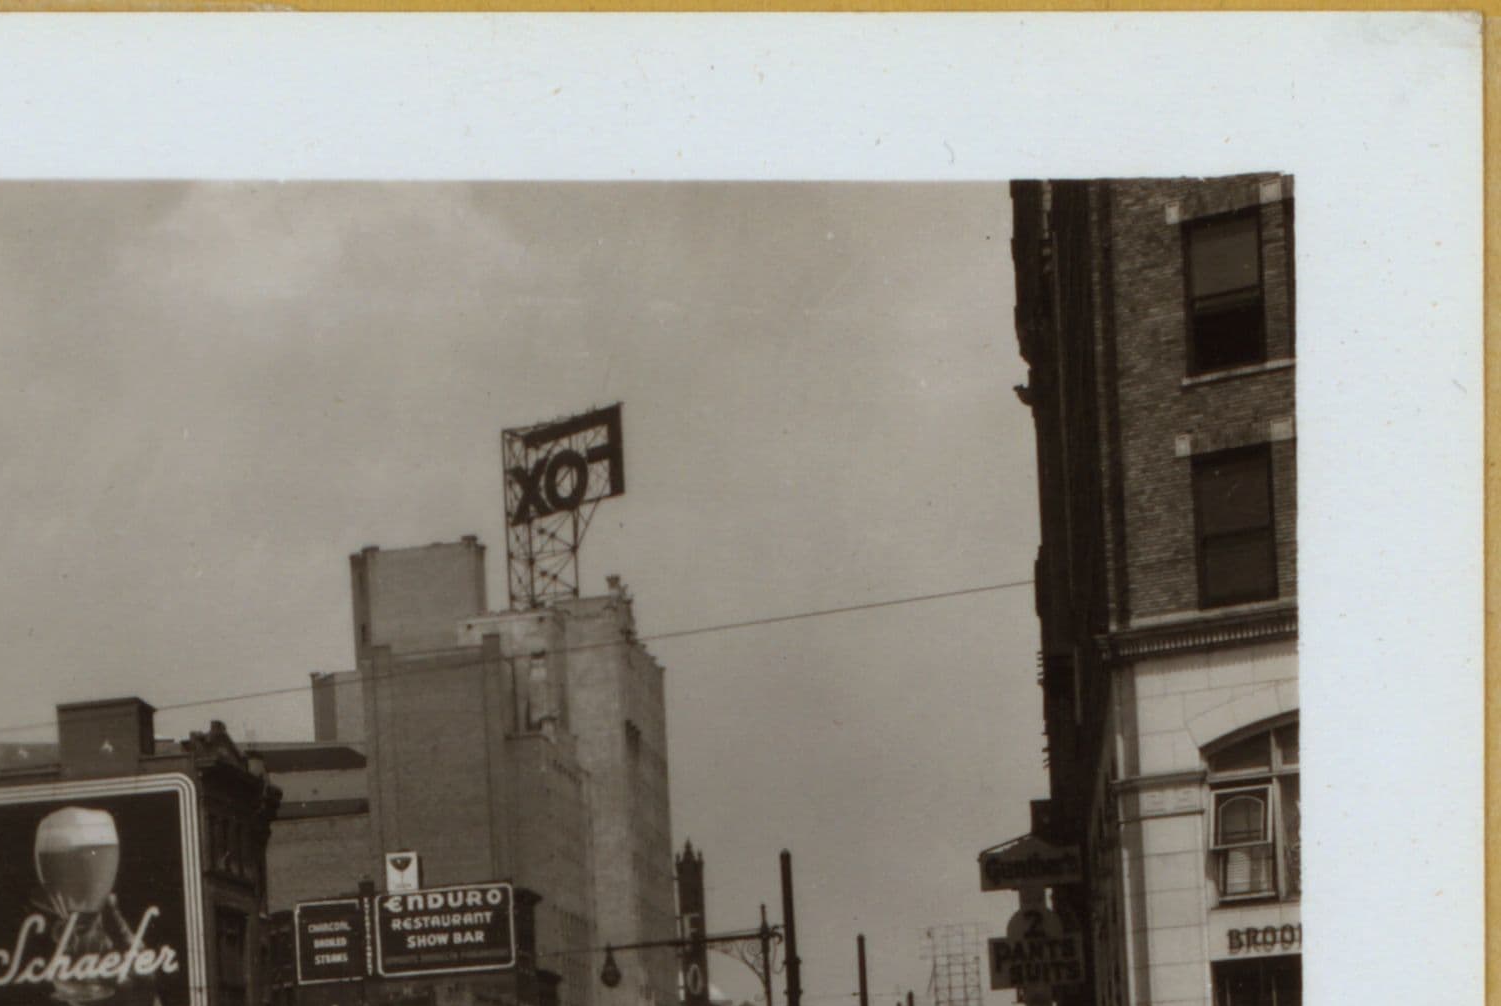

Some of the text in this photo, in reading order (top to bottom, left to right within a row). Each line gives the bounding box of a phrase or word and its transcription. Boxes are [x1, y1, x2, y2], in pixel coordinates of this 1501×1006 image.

[384, 888, 502, 913] ENDURO
[391, 911, 493, 931] RESTAURANT
[1024, 910, 1045, 938] 2
[407, 930, 485, 949] SHOW BAR
[993, 938, 1075, 972] PANTS
[1009, 961, 1080, 986] SUITS
